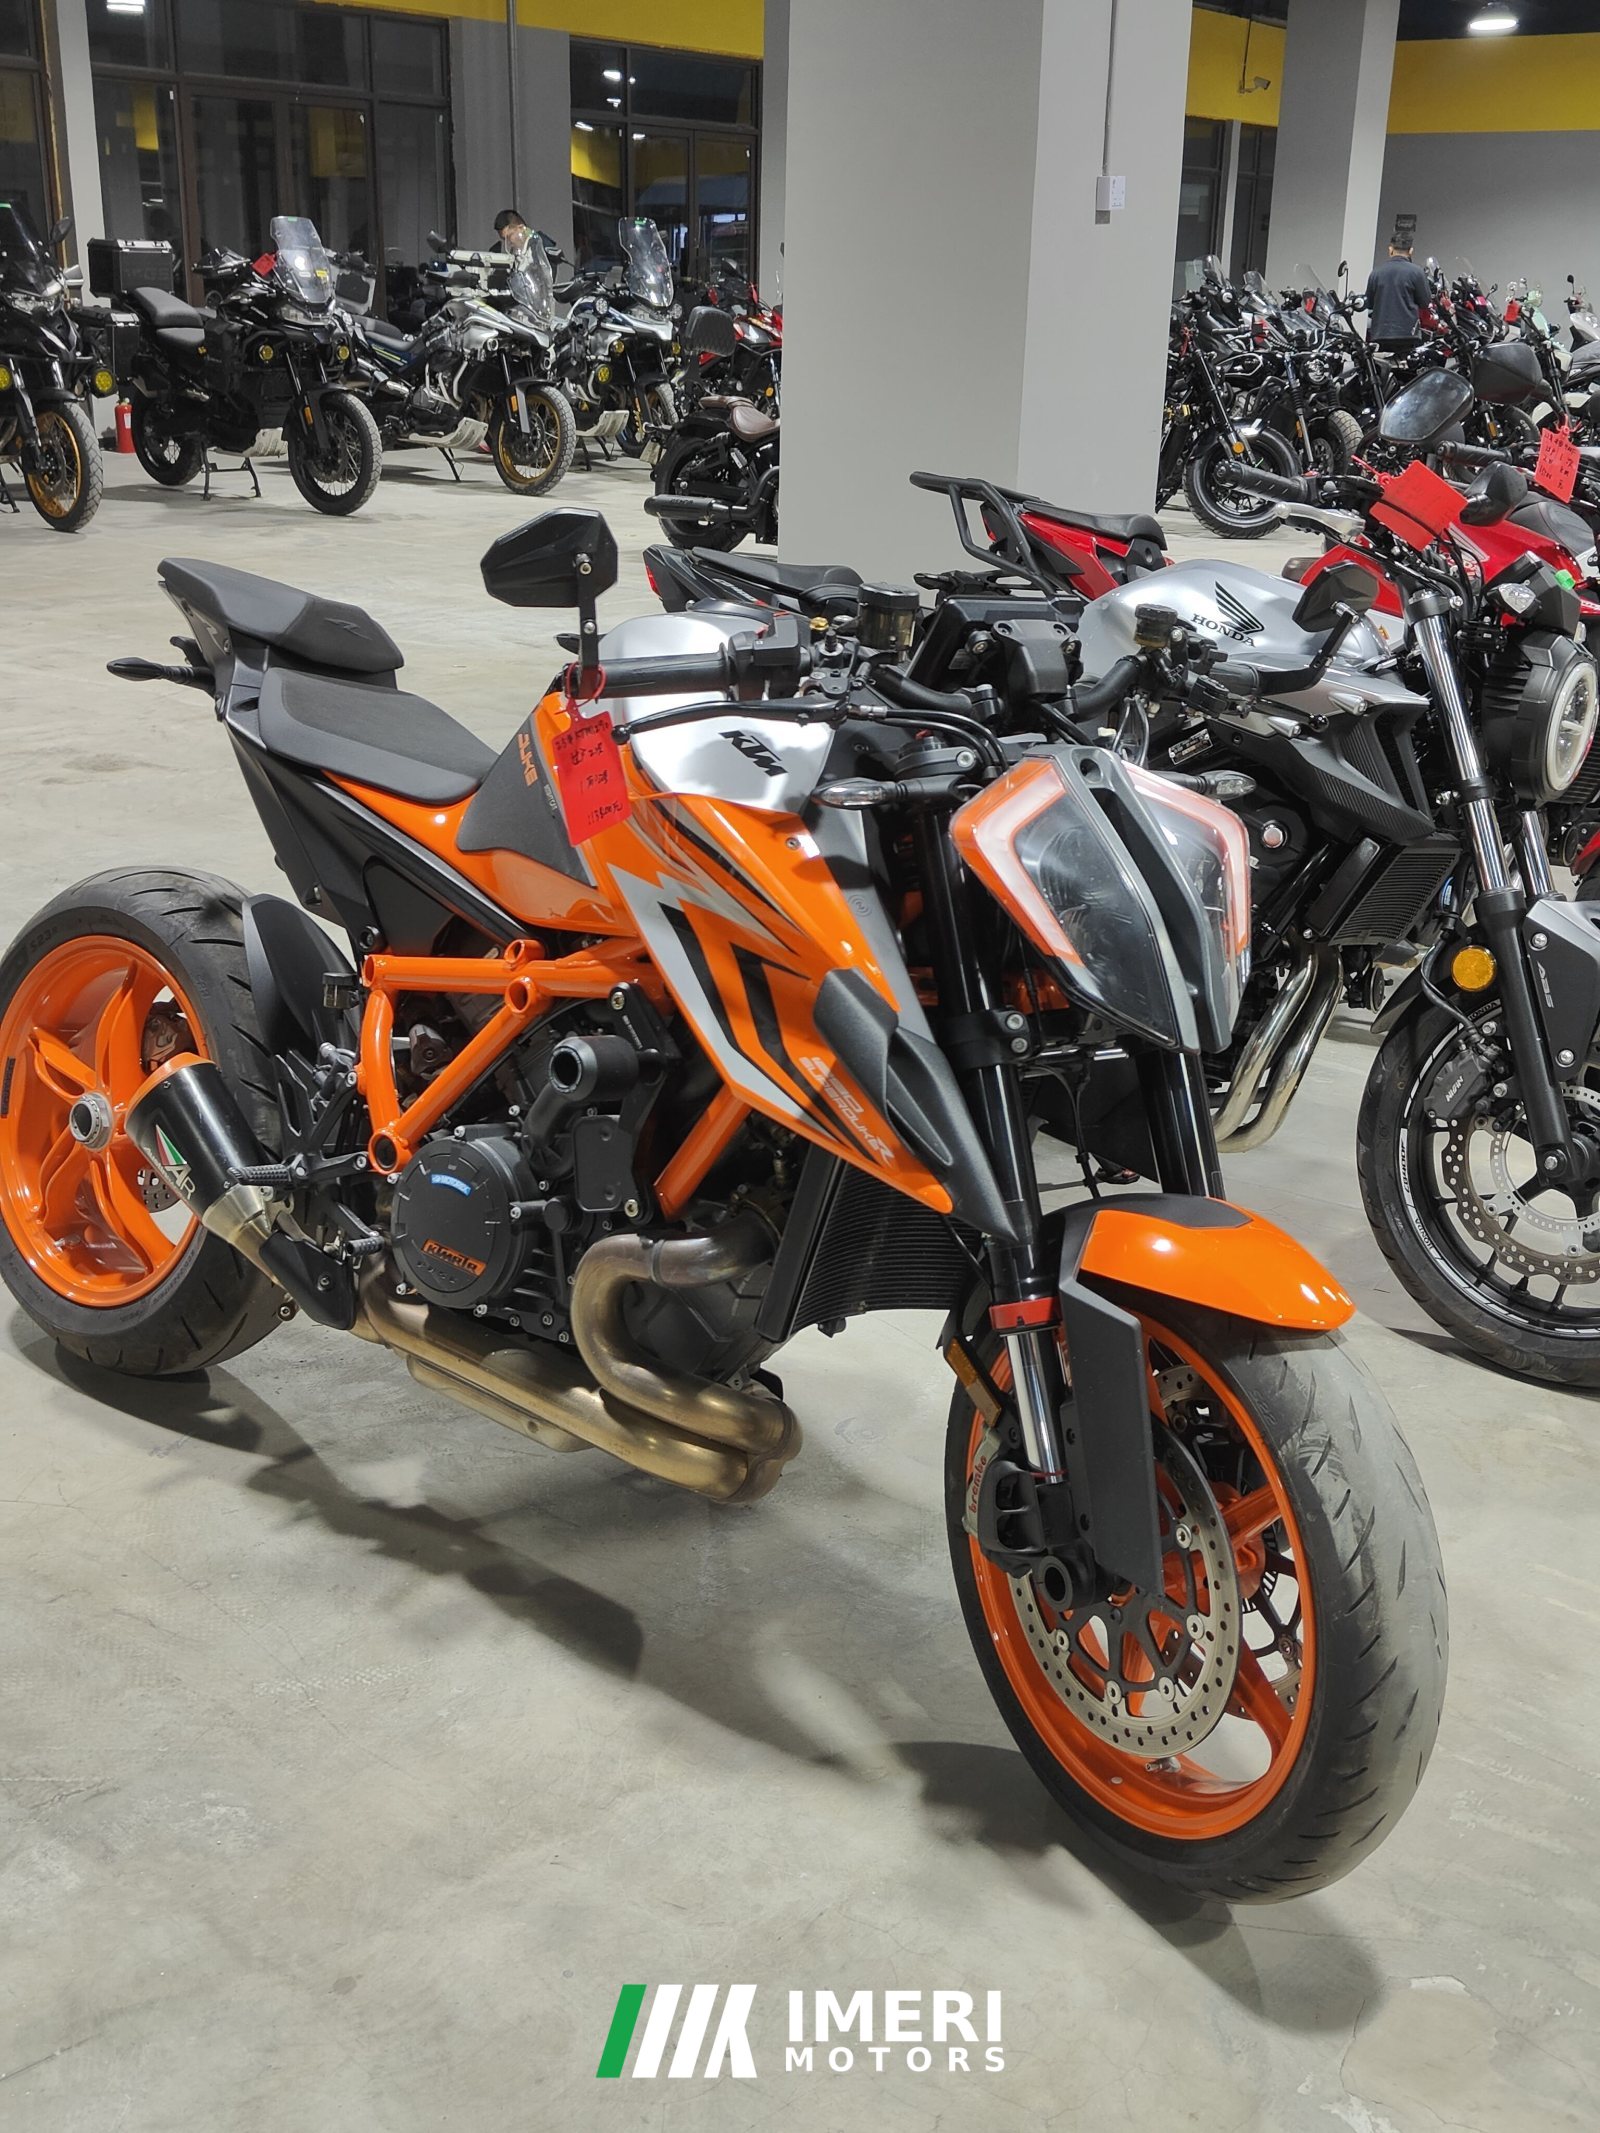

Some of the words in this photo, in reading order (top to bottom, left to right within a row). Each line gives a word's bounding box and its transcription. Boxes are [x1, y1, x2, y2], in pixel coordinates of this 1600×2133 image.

[1190, 612, 1257, 648] HONDA
[718, 729, 787, 778] KTM
[1536, 961, 1555, 1010] ABS
[164, 1164, 196, 1200] AR
[1413, 1217, 1434, 1251] HONDA
[968, 1454, 988, 1514] brembo
